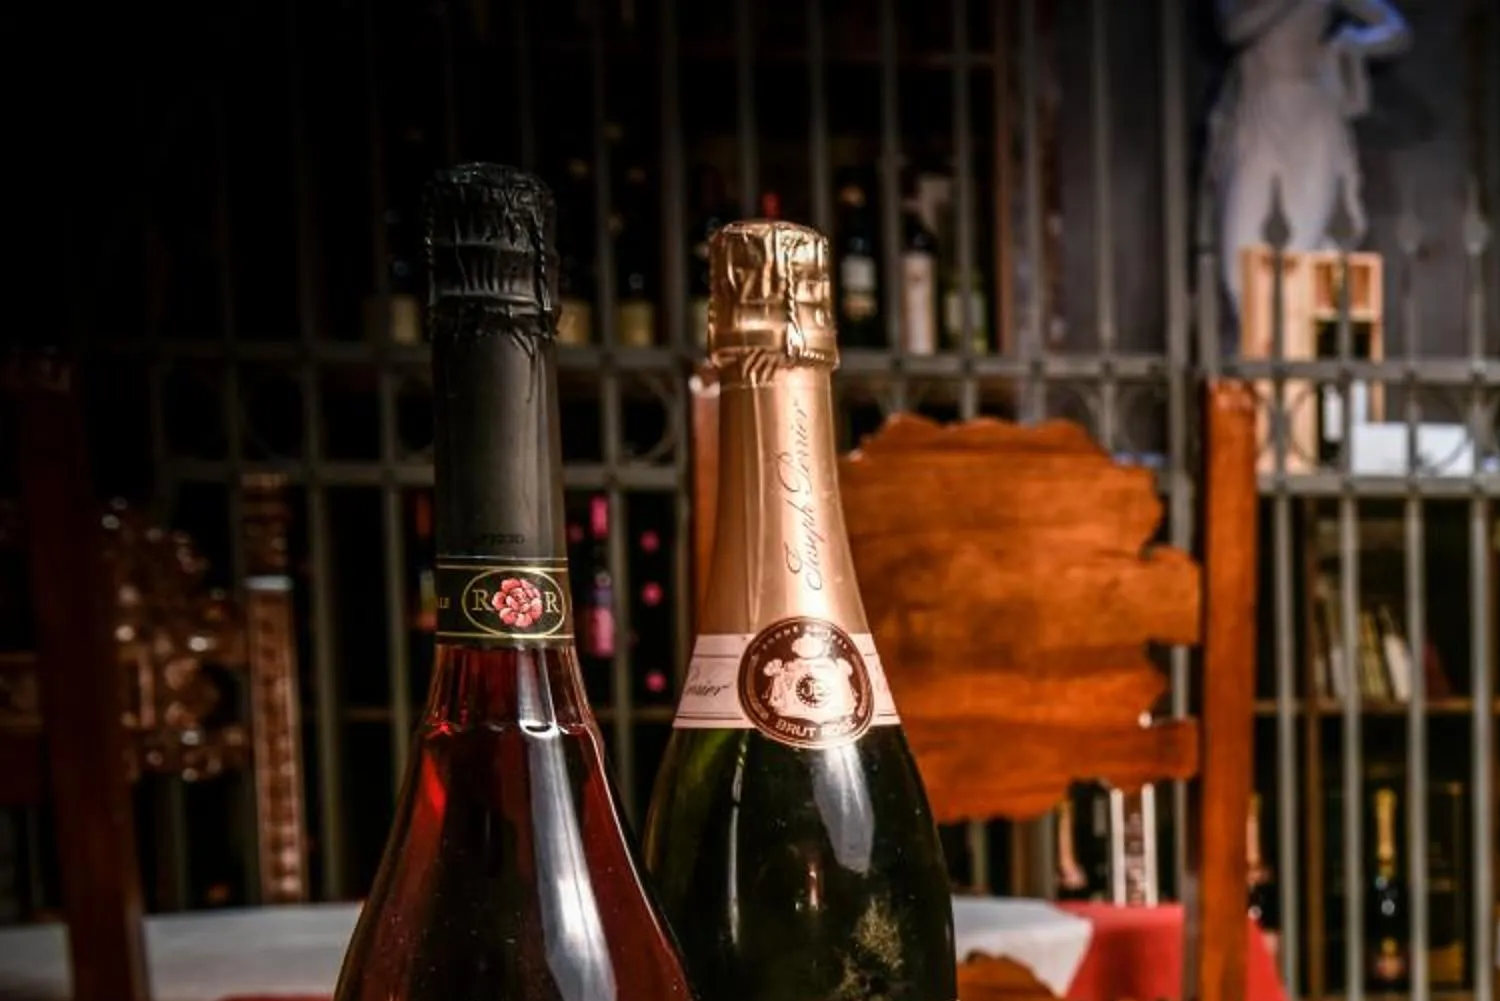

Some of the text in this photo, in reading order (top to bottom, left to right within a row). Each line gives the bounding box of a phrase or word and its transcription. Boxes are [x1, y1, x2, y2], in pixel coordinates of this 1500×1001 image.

[775, 399, 813, 496] Perrier
[783, 499, 825, 591] Joseph
[471, 589, 496, 611] R
[544, 591, 560, 613] R
[775, 717, 818, 738] BRUT
